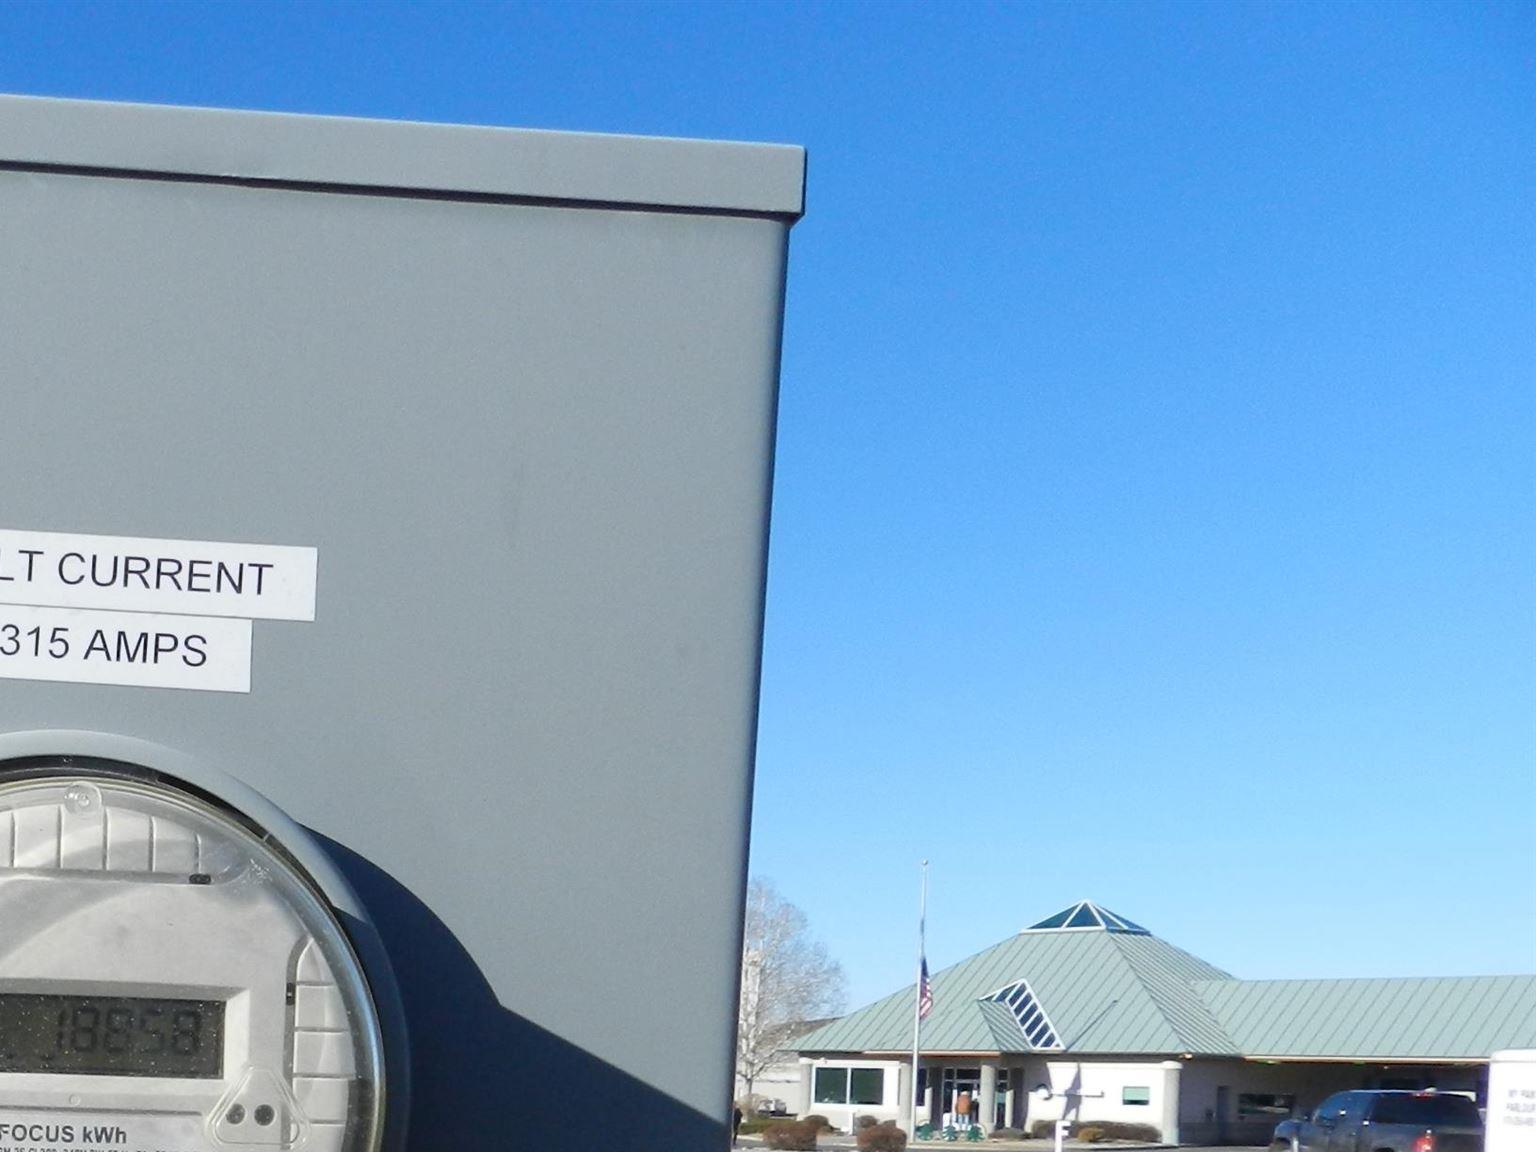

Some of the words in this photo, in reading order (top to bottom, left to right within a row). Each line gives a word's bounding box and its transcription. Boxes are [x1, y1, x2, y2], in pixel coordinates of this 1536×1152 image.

[58, 552, 274, 595] CURRENT
[83, 629, 208, 667] AMPS
[82, 1126, 127, 1144] kWh
